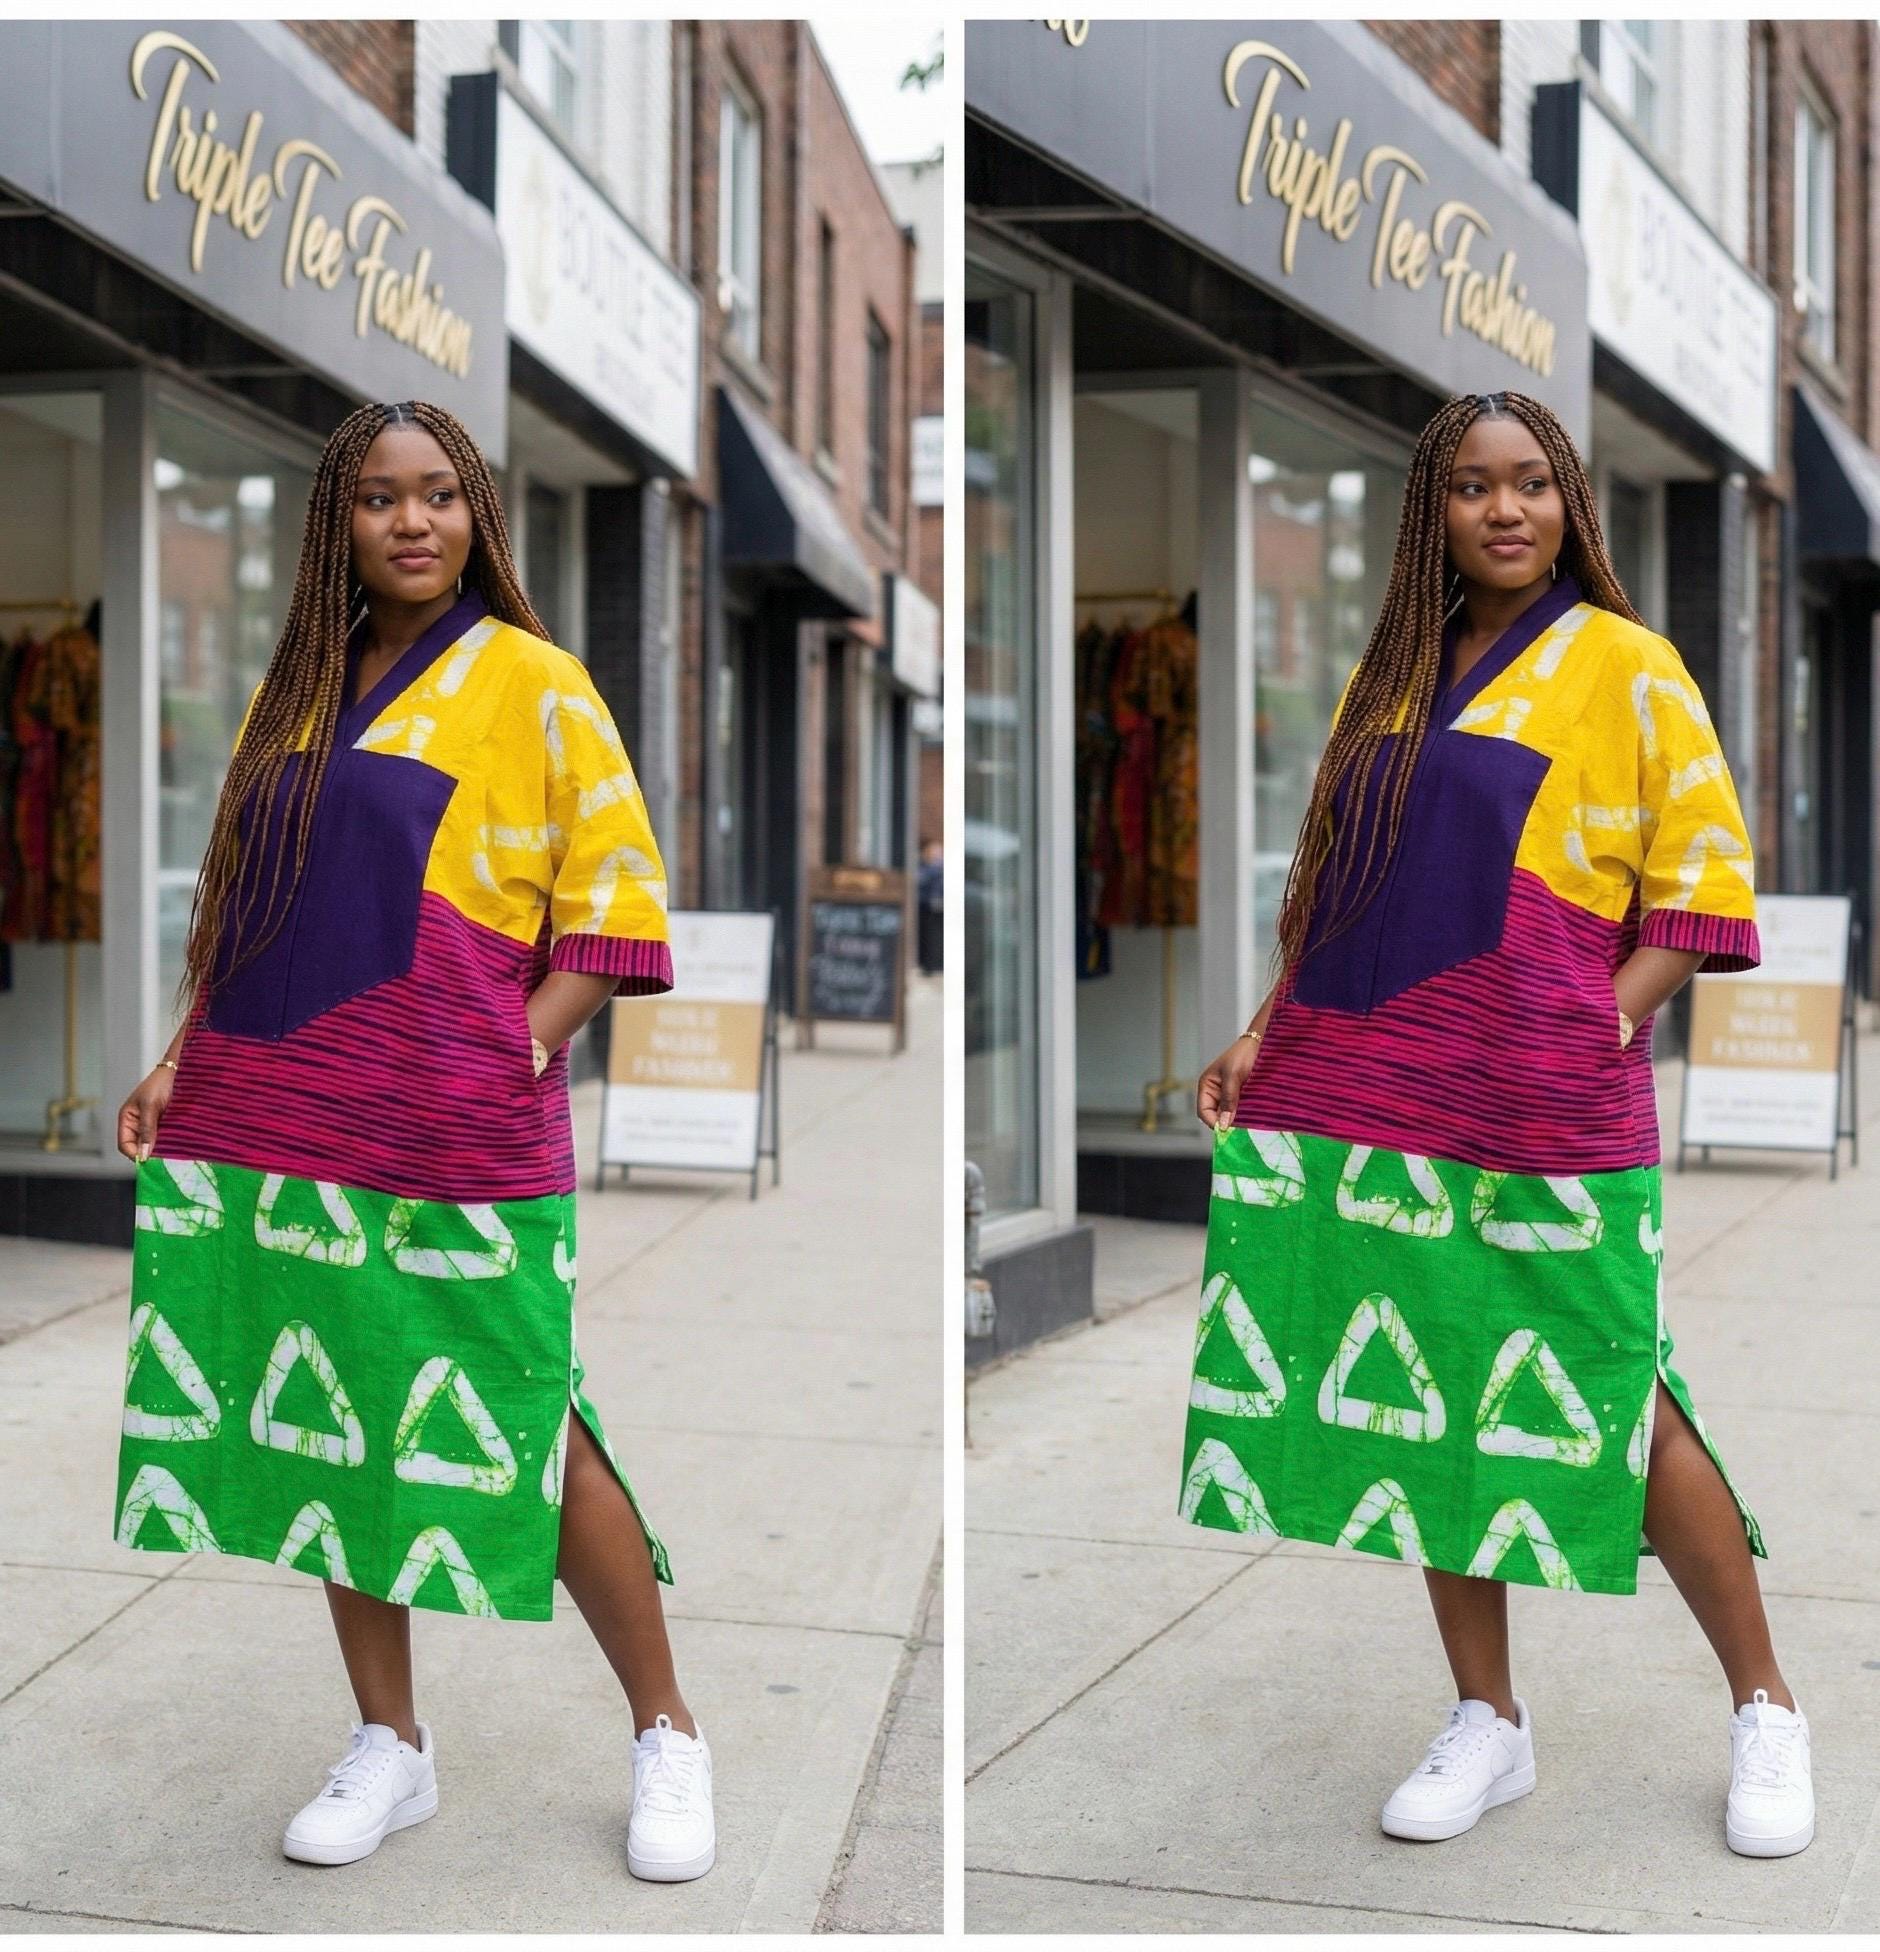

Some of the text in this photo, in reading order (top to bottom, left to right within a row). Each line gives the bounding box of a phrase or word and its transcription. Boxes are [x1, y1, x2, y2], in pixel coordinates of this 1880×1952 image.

[131, 31, 273, 273] Triple
[272, 139, 344, 290] Tee
[347, 195, 473, 378] Fashion
[1225, 40, 1361, 276] Triple
[1361, 145, 1430, 291] Tee
[1433, 200, 1557, 378] Fashion
